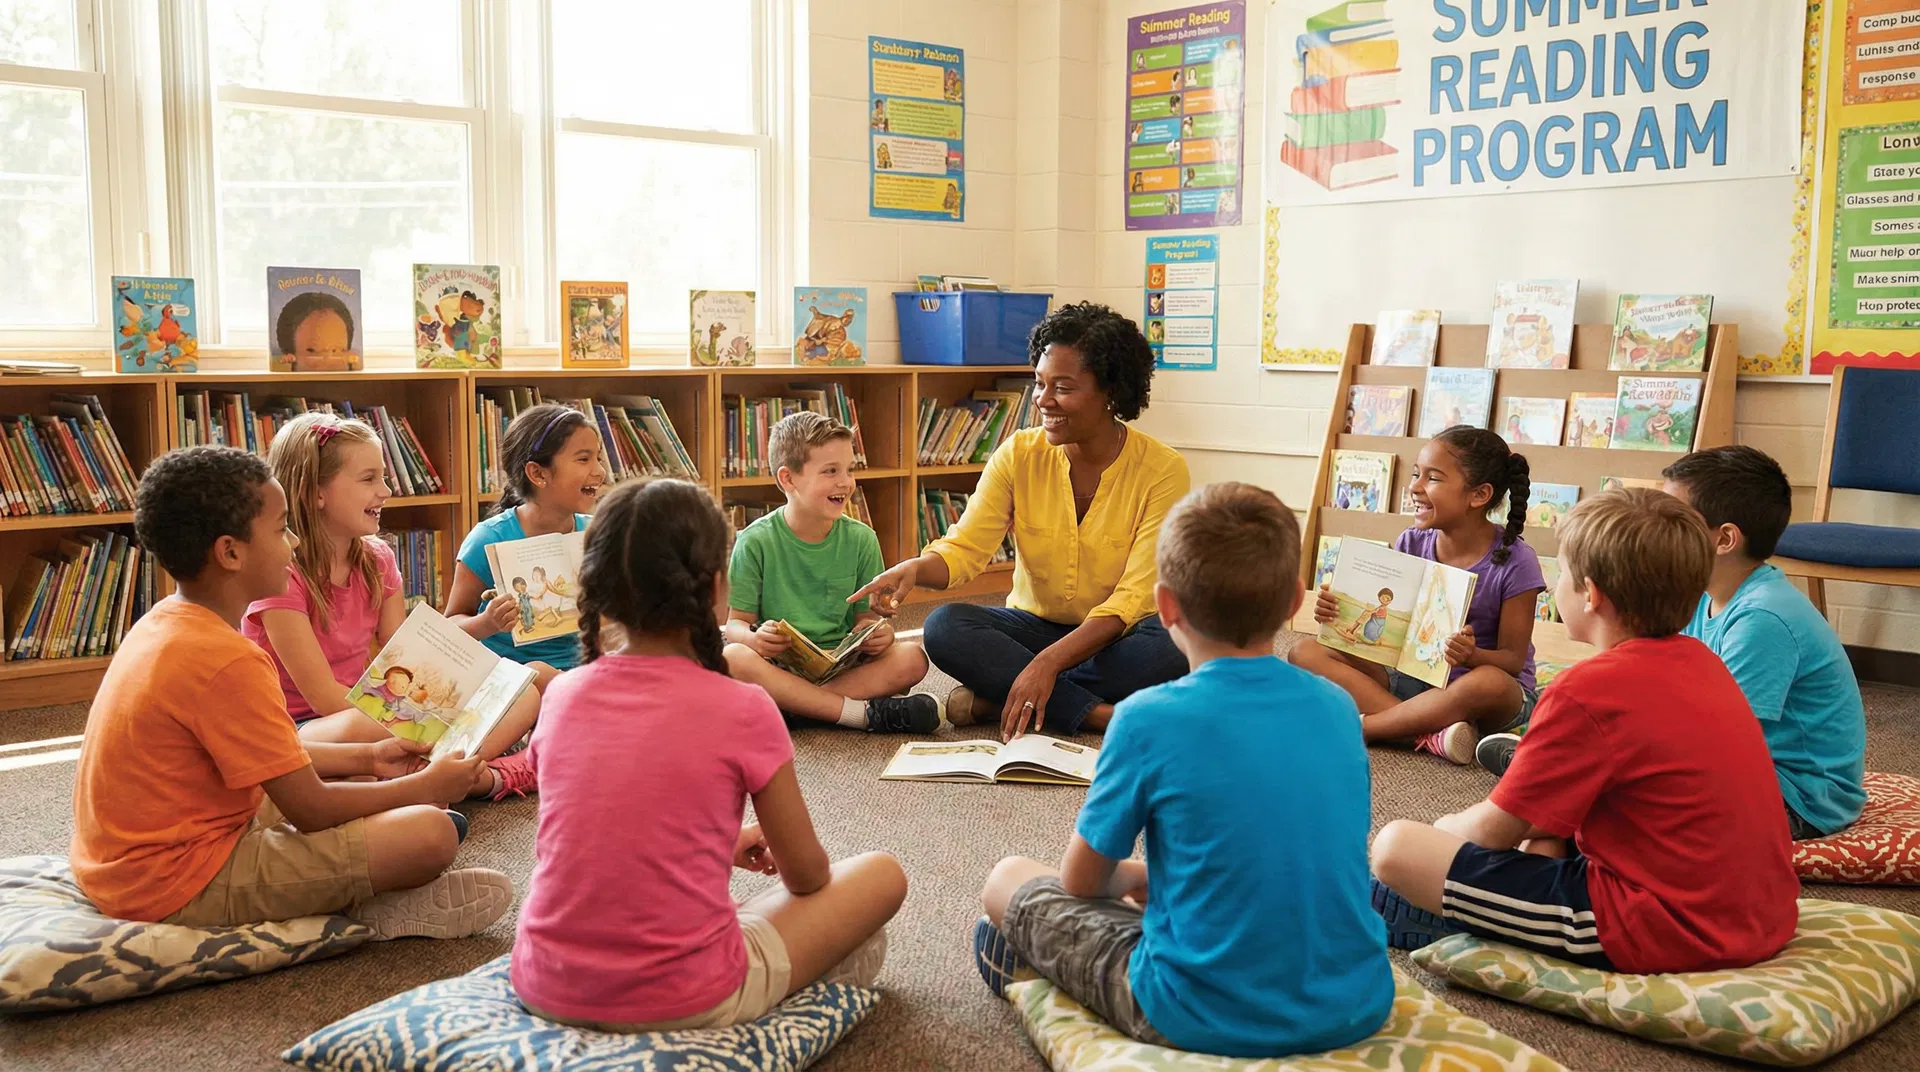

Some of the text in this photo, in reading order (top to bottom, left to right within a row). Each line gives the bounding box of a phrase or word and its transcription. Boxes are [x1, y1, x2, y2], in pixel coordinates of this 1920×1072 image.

[1140, 9, 1230, 34] Summer Reading
[1863, 17, 1897, 29] Camp
[1897, 41, 1920, 52] and
[1429, 21, 1710, 115] READING
[1862, 71, 1916, 85] response
[1413, 99, 1728, 187] PROGRAM
[1846, 195, 1889, 205] Glasses
[1892, 193, 1914, 203] and
[1874, 221, 1914, 232] Somes
[1880, 247, 1904, 258] help
[1857, 275, 1888, 284] Make
